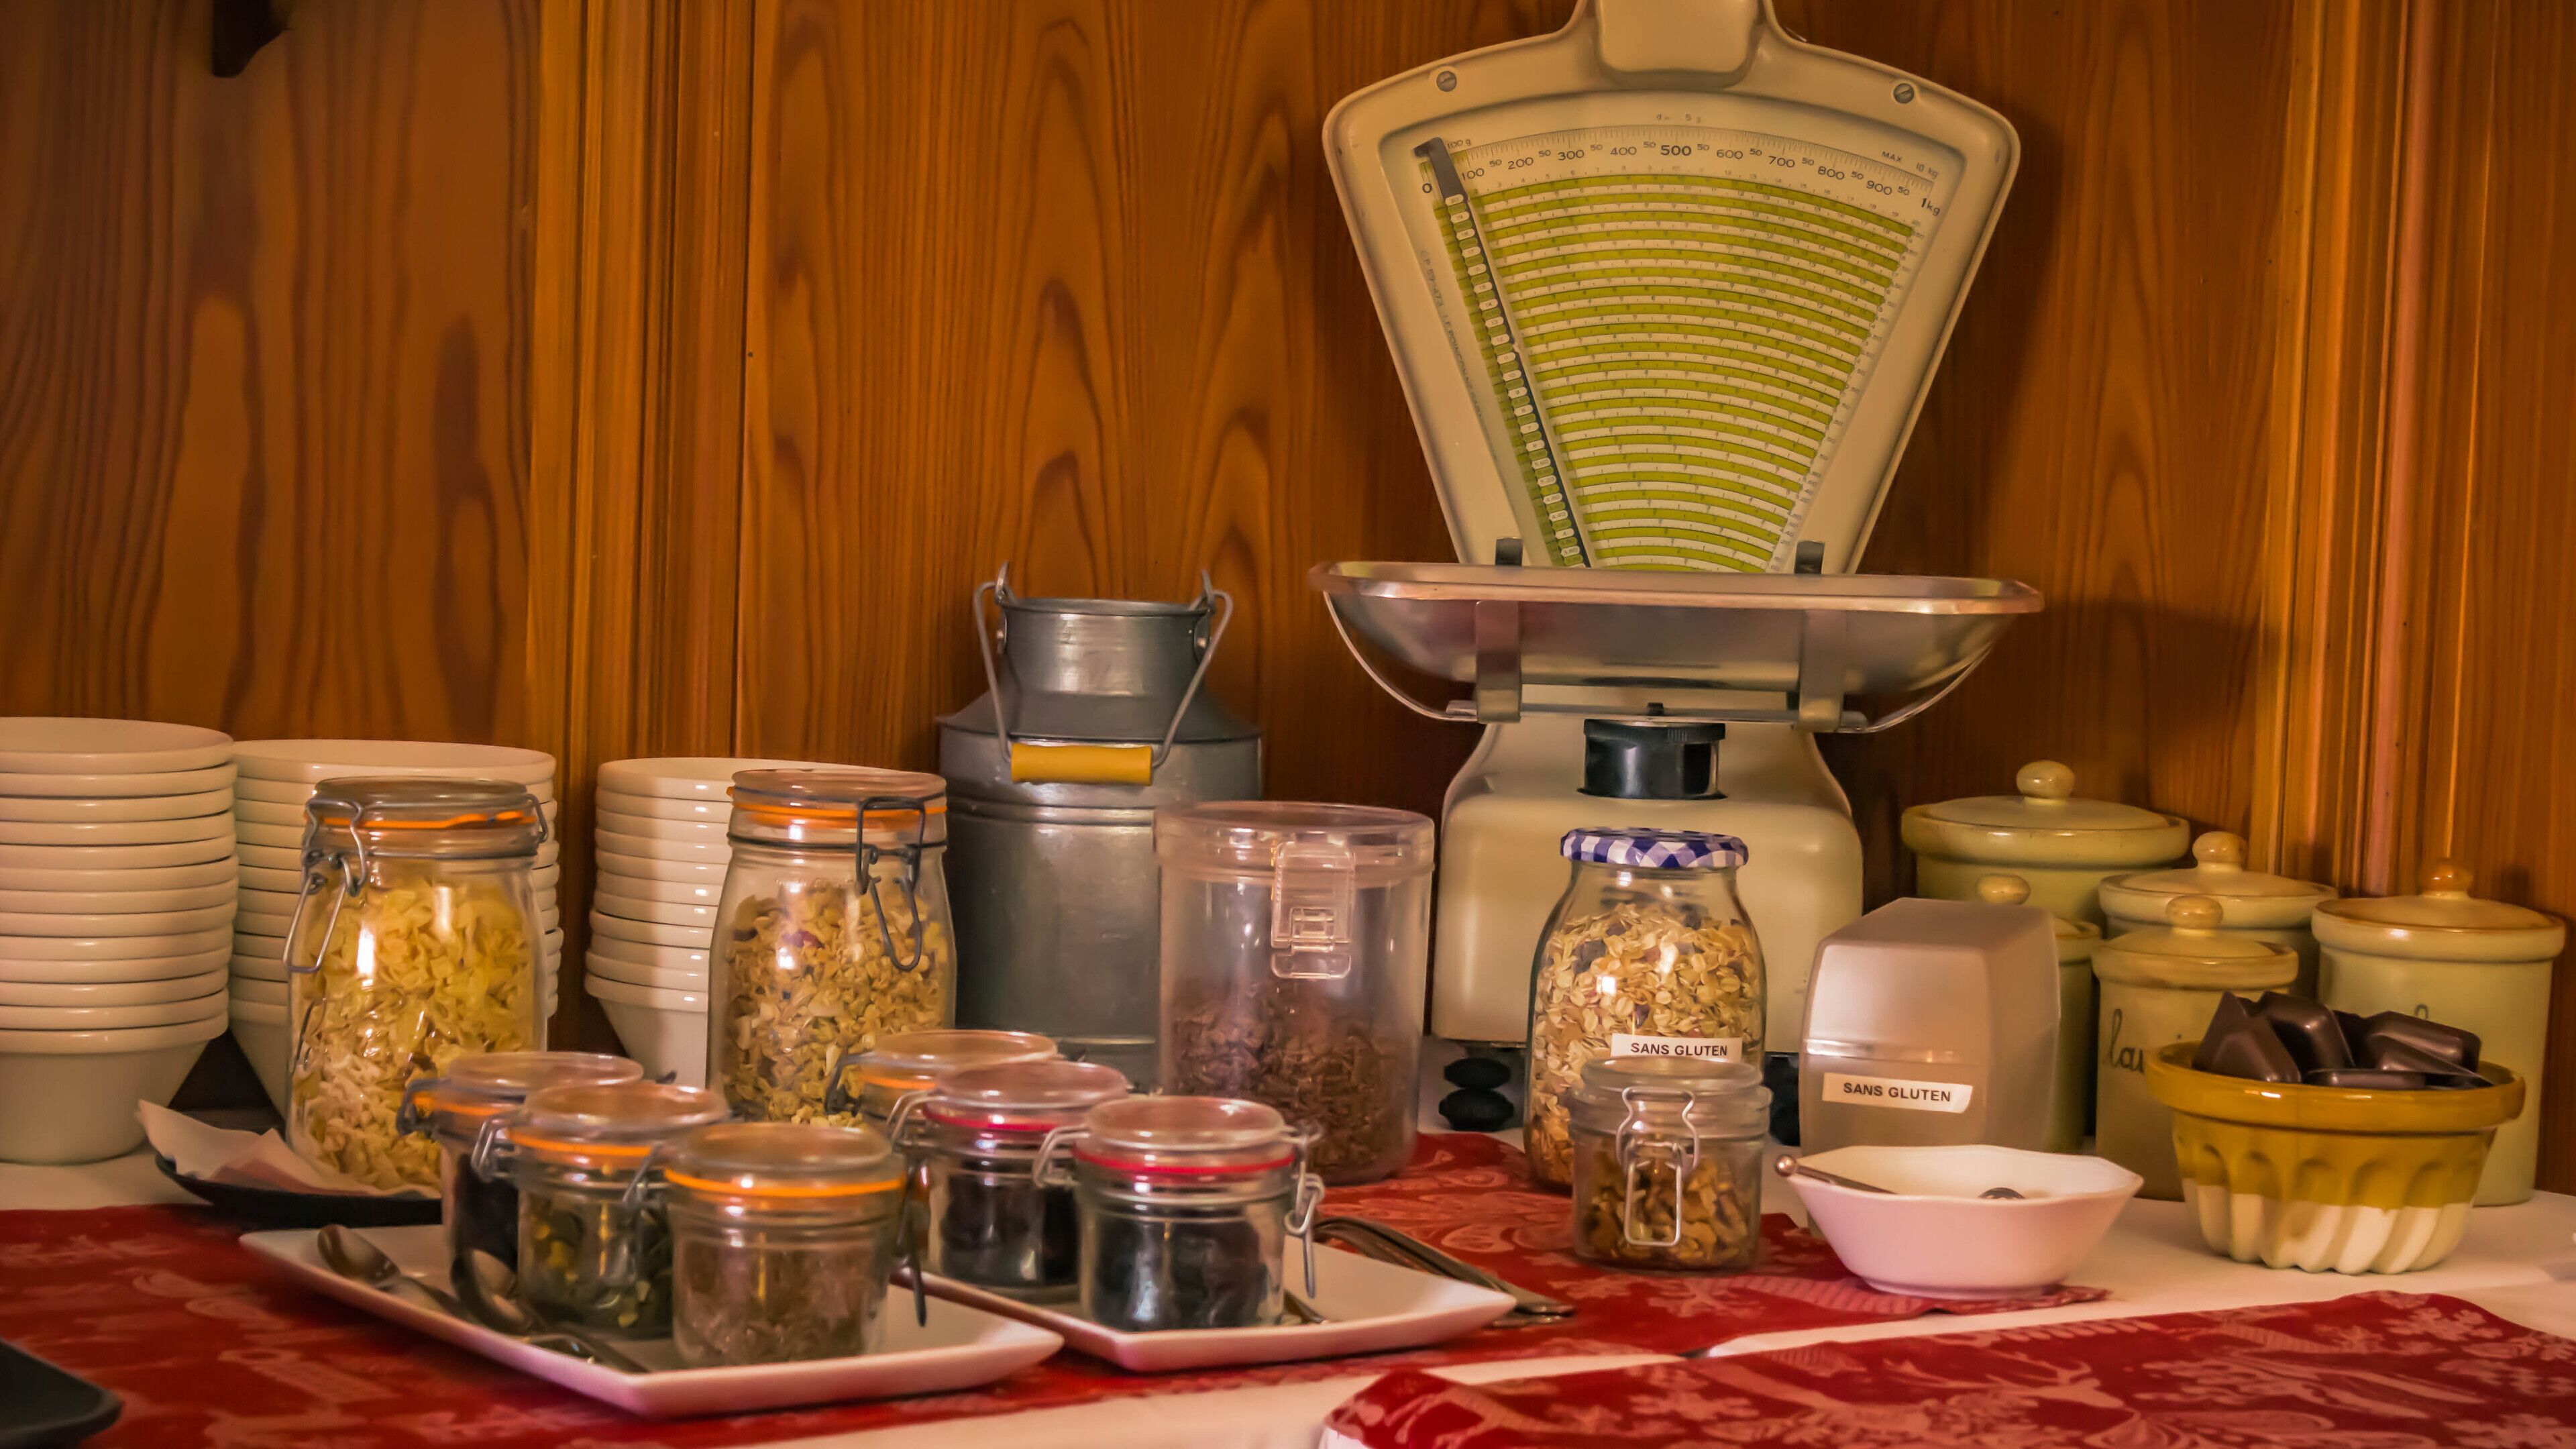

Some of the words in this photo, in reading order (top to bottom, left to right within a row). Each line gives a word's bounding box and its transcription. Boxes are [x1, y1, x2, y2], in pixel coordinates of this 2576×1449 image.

[1447, 139, 1464, 149] 100
[1882, 151, 1902, 162] MAX
[1422, 182, 1433, 194] 0
[1461, 168, 1485, 180] 100
[1489, 159, 1502, 167] 50
[1507, 157, 1534, 170] 200
[1558, 150, 1585, 161] 300
[1610, 146, 1637, 156] 400
[1660, 145, 1691, 156] 500
[1716, 149, 1743, 160] 600
[1750, 148, 1762, 156] 50
[1768, 155, 1795, 168] 700
[1801, 158, 1814, 166] 50
[1817, 166, 1845, 180] 800
[1850, 171, 1864, 180] 50
[1866, 180, 1892, 195] 900
[1897, 186, 1910, 195] 50
[1630, 1042, 1669, 1055] SANS
[1674, 1044, 1727, 1057] GLUTEN
[1843, 1081, 1883, 1097] SANS
[1888, 1086, 1951, 1102] GLUTEN
